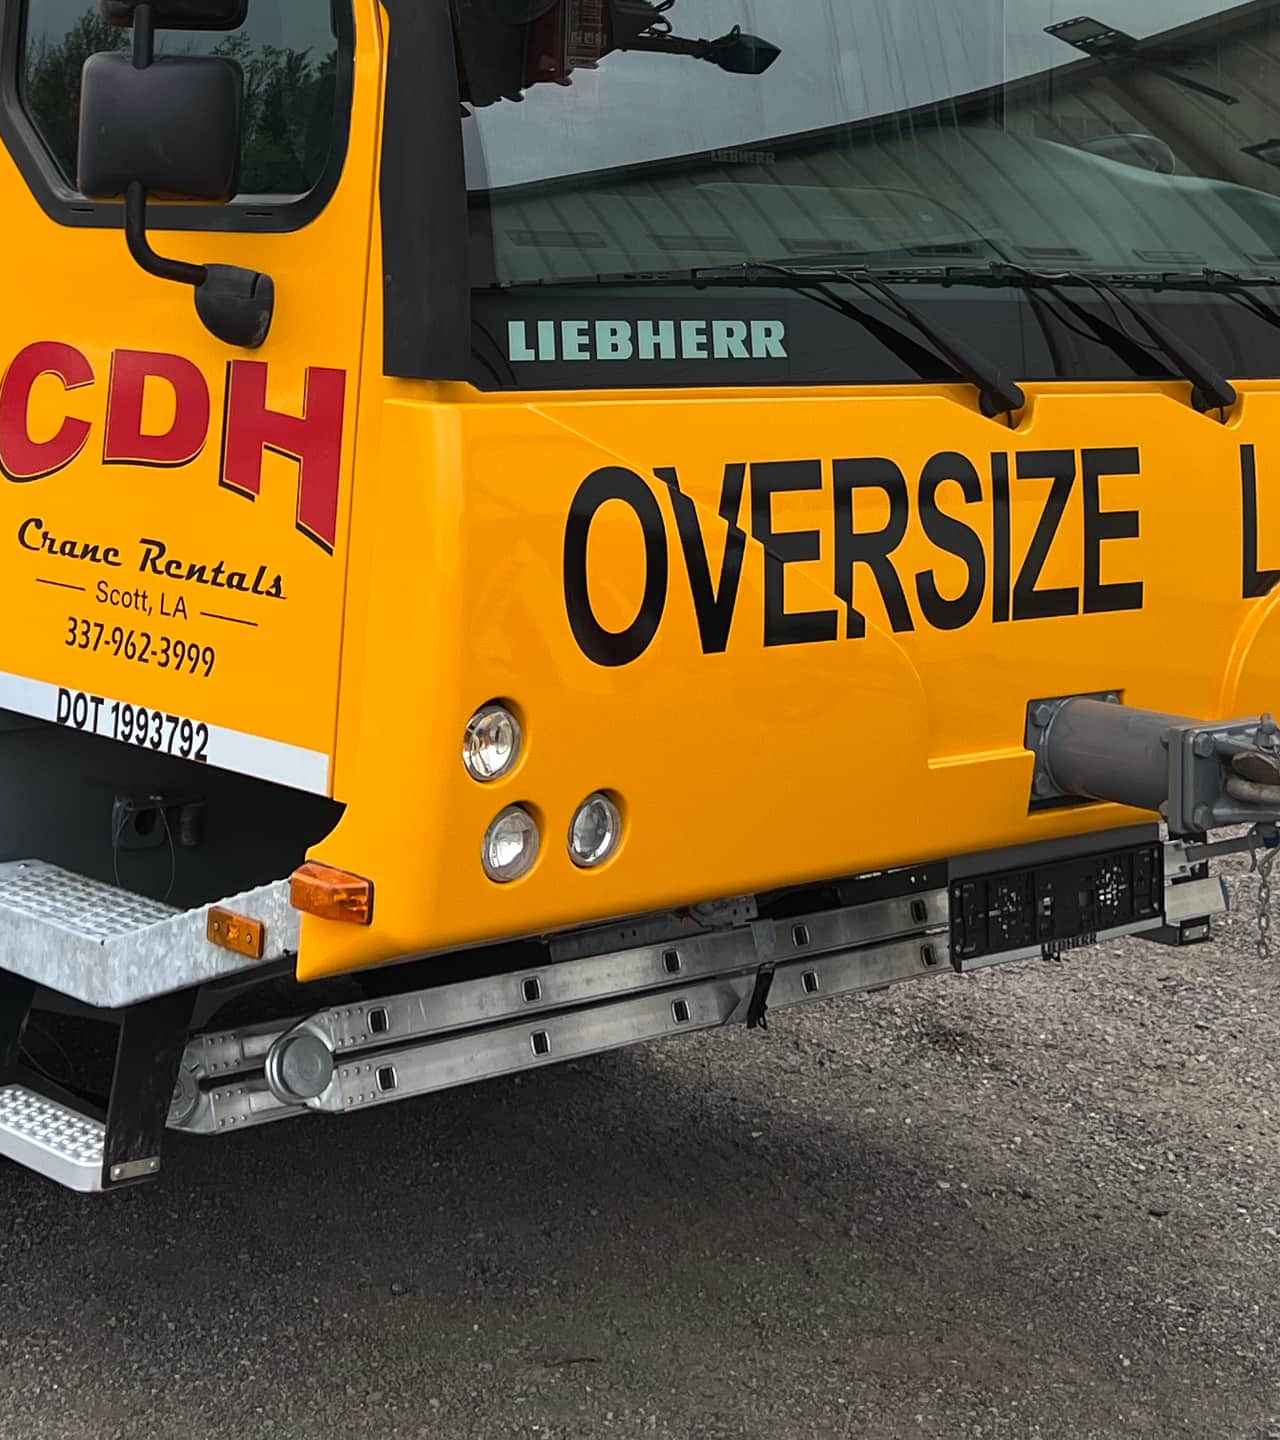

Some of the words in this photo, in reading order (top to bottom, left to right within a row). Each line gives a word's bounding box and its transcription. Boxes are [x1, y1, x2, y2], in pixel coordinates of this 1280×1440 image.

[508, 320, 788, 362] LIEBHERR
[17, 517, 123, 568] Crane
[138, 537, 289, 601] Rentals
[562, 447, 1145, 667] OVERSIZE
[95, 579, 155, 616] Scott,
[159, 592, 189, 621] LA
[64, 616, 216, 678] 337-962-3999
[56, 687, 105, 735] DOT
[110, 700, 210, 762] 1993792
